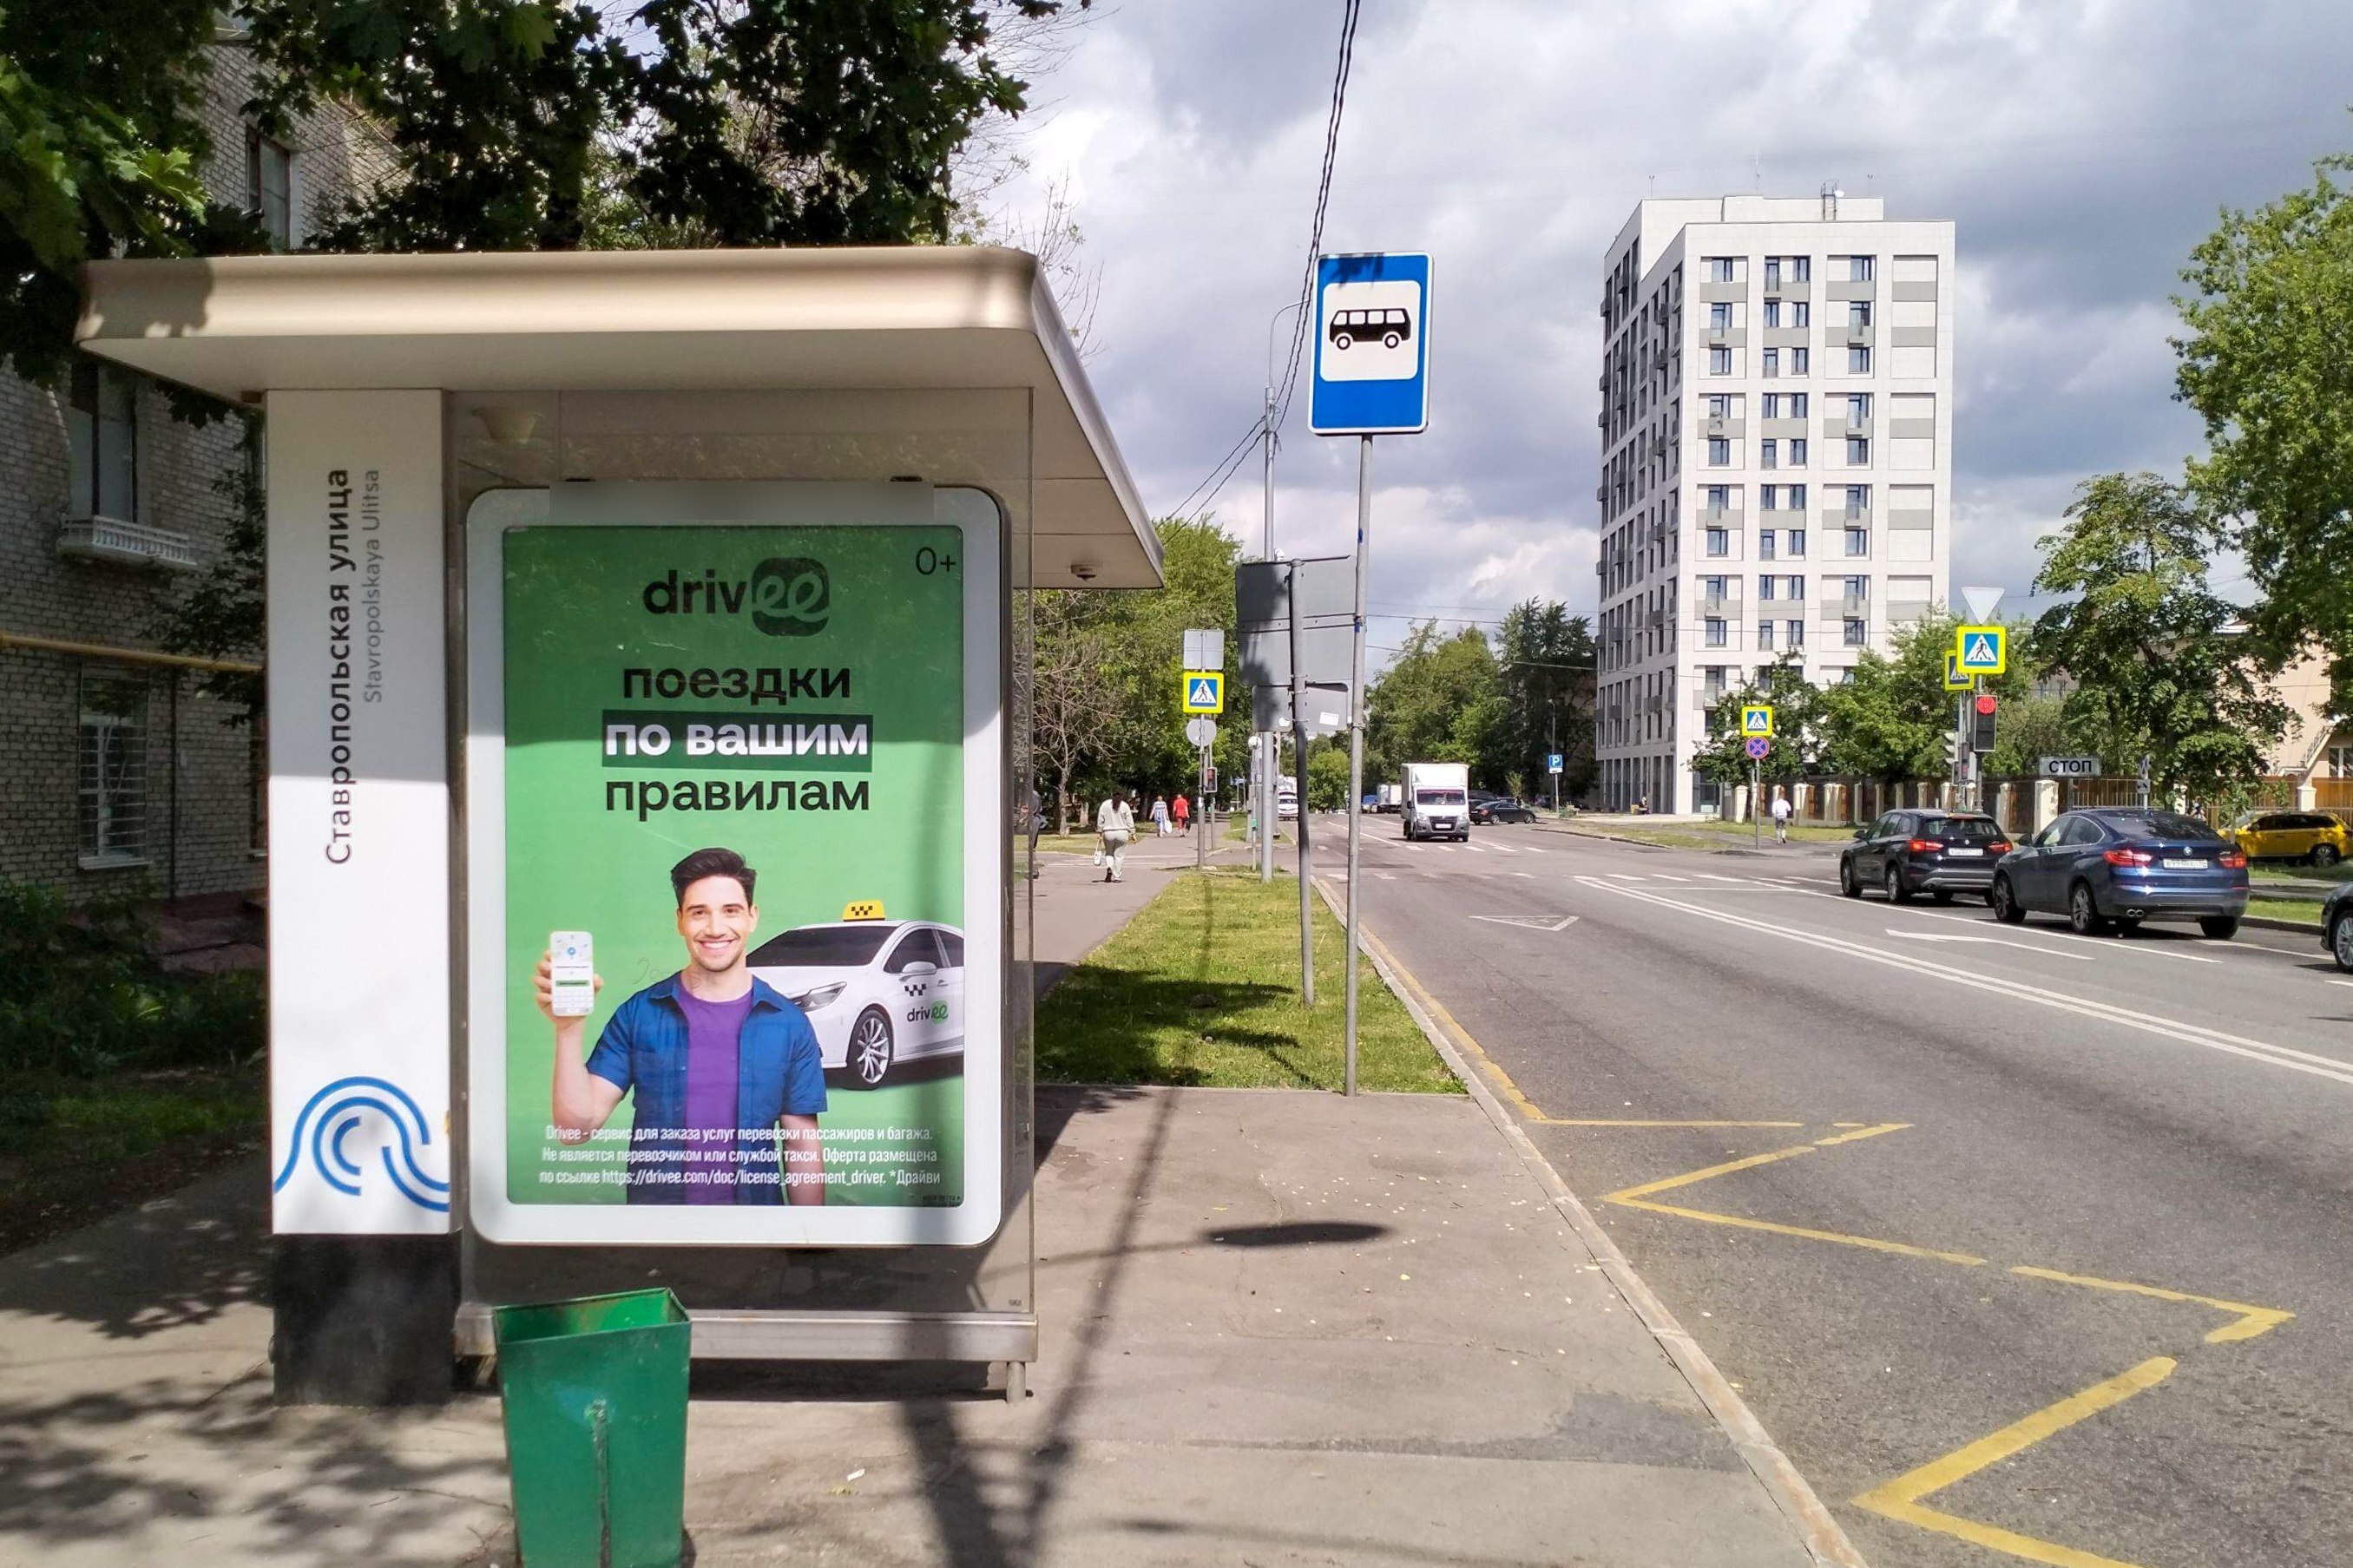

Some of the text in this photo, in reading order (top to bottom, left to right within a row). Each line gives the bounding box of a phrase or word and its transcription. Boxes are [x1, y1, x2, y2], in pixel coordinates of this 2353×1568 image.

[916, 547, 956, 574] 0+
[361, 470, 384, 703] Stavropolskaya Ulitsa
[642, 562, 830, 628] drivee
[326, 469, 357, 864] Ставропольская улица
[623, 667, 851, 705] поездки
[606, 724, 868, 756] по вашим
[2048, 760, 2092, 772] СТОП
[606, 781, 870, 822] правилам
[907, 1004, 949, 1022] drivee
[590, 1129, 632, 1143] сервис
[634, 1129, 658, 1142] для
[661, 1129, 700, 1140] заказа
[703, 1129, 735, 1144] услуг
[738, 1129, 799, 1143] перевозки
[803, 1129, 875, 1143] пассажиров
[877, 1130, 884, 1139] и
[887, 1126, 933, 1140] багажа.
[542, 1147, 937, 1165] Не является перевозчиком или службой такси. Оферта размещена
[539, 1171, 555, 1183] по
[555, 1171, 601, 1183] ссылке
